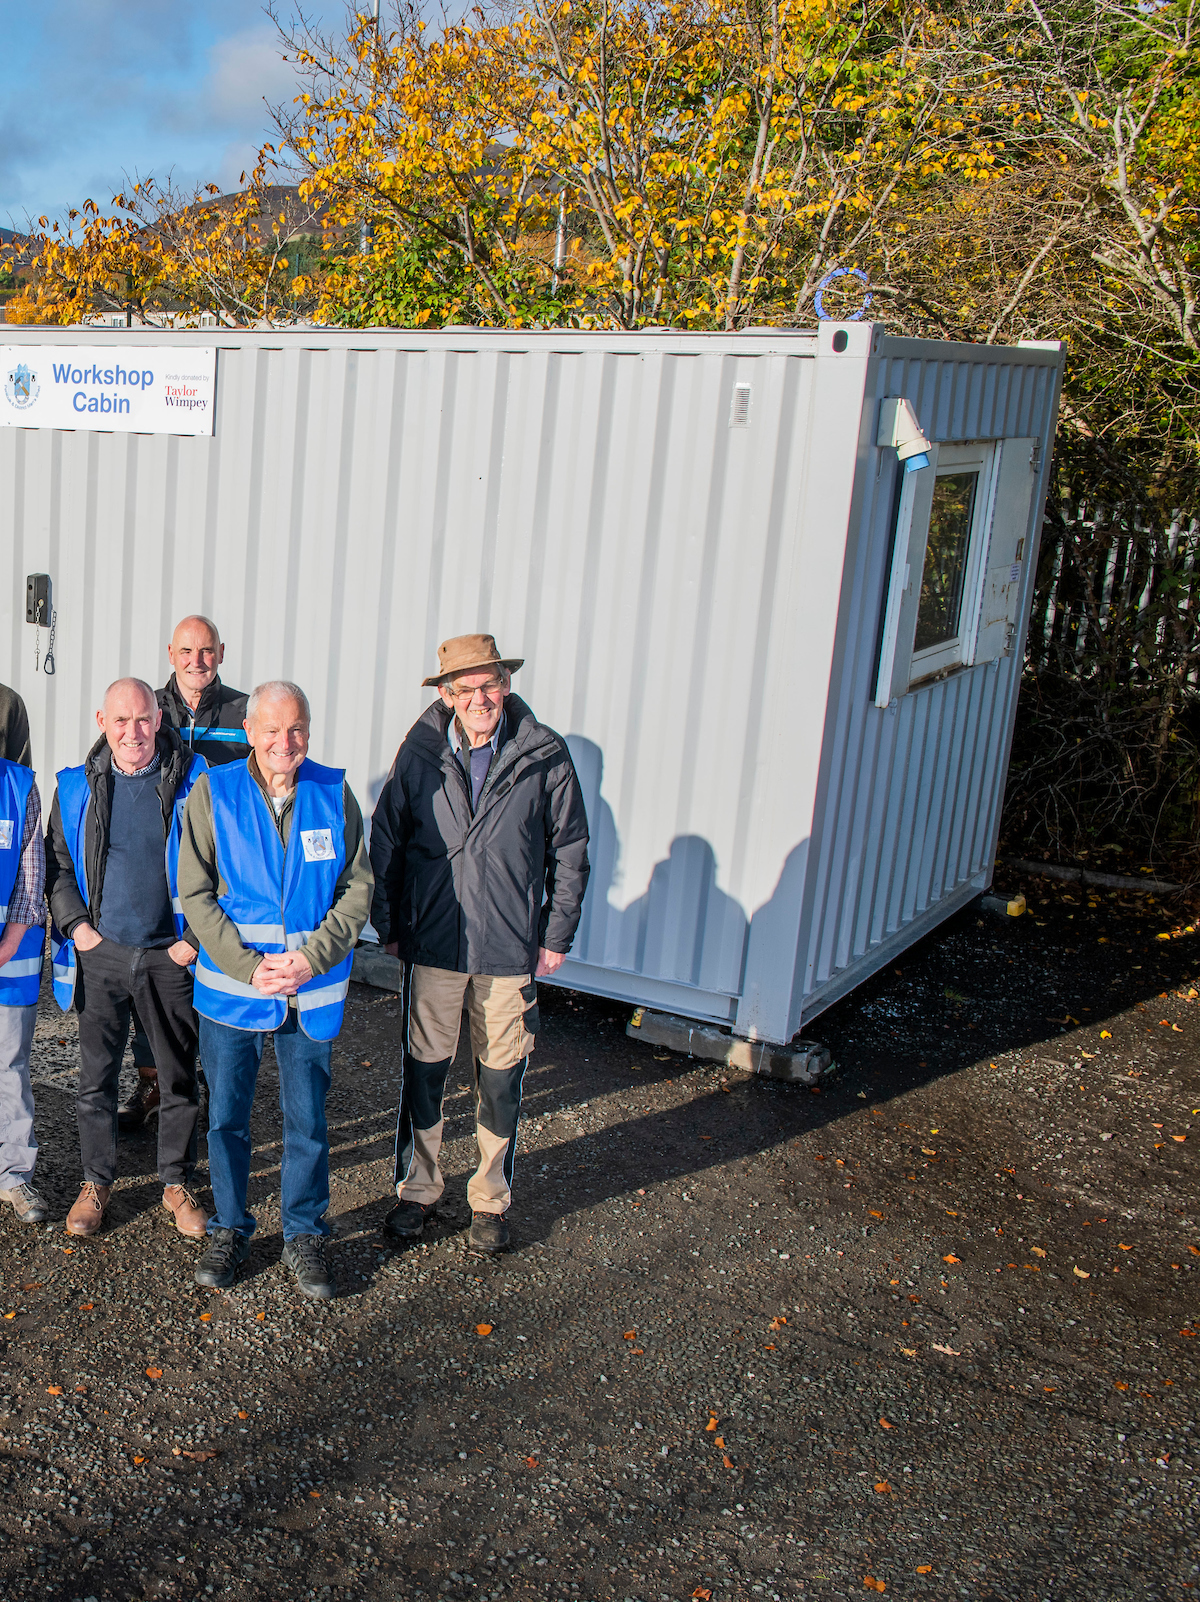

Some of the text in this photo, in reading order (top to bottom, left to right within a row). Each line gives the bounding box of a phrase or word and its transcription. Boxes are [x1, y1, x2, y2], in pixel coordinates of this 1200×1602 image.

[52, 363, 154, 390] Workshop
[165, 385, 198, 399] Taylor
[72, 391, 130, 413] Cabin
[165, 396, 208, 411] Wimpey
